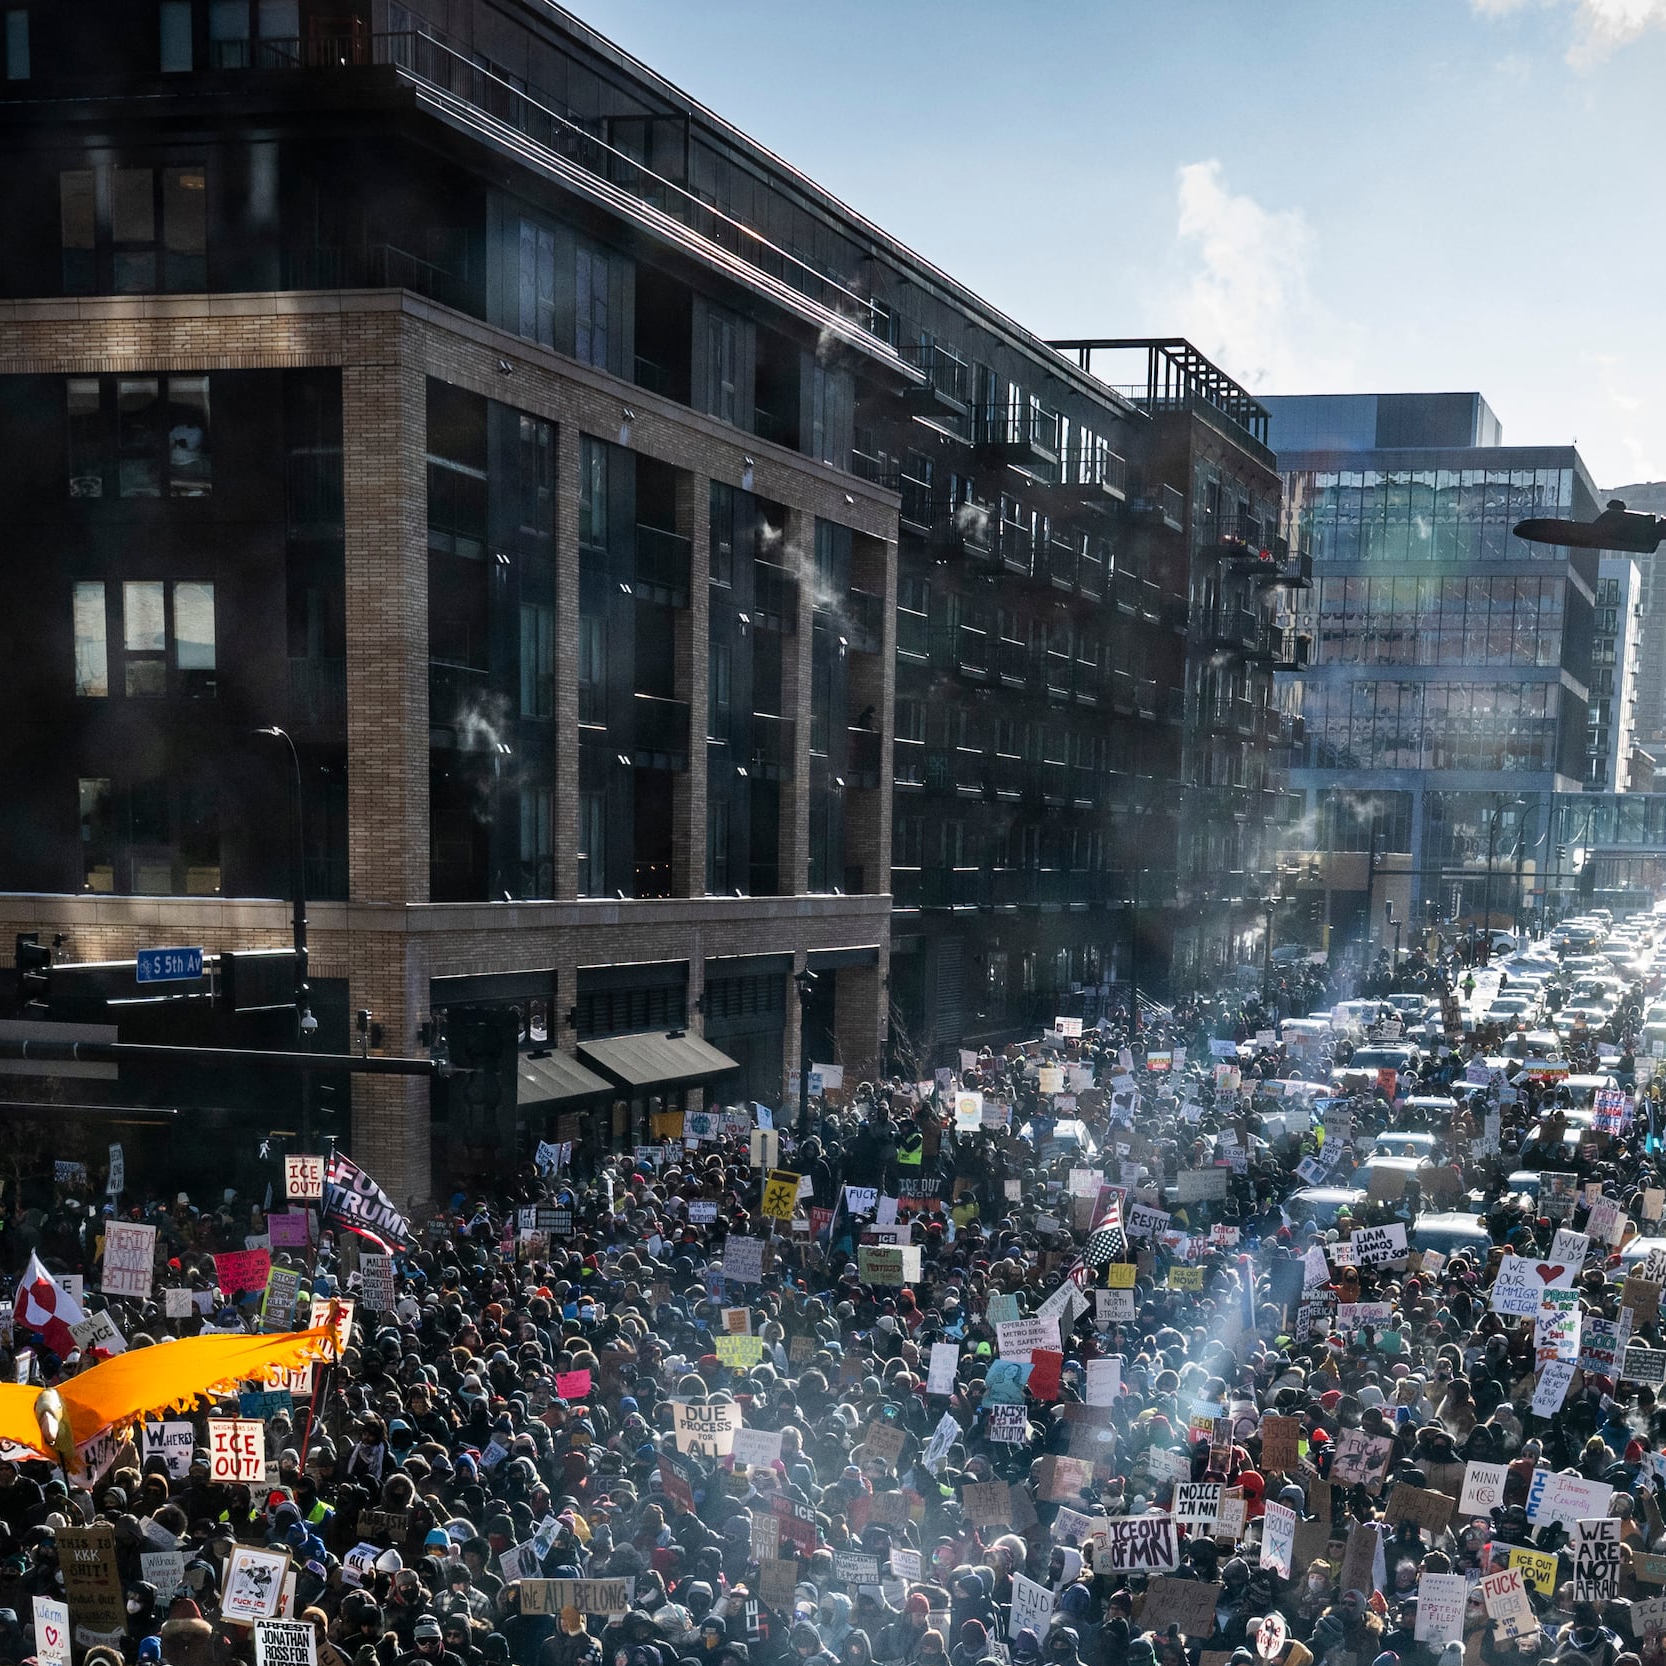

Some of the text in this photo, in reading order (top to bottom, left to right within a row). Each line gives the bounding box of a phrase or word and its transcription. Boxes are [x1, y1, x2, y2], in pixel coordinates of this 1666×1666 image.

[154, 957, 202, 973] S 5th Av
[289, 1165, 318, 1179] ICE
[290, 1181, 320, 1195] OUT!
[1357, 1229, 1386, 1244] LIAM
[1356, 1239, 1393, 1254] RAMOS
[1391, 1248, 1408, 1258] SON
[1104, 1298, 1127, 1306] NORTH
[1099, 1311, 1133, 1319] STRONGER
[686, 1406, 727, 1421] DUE
[994, 1406, 1026, 1417] RACISM
[680, 1419, 732, 1432] PROCESS
[698, 1433, 714, 1441] FOR
[687, 1440, 718, 1458] ALL
[793, 1505, 815, 1521] ICE
[1579, 1522, 1615, 1541] WE
[1579, 1541, 1619, 1561] ARE
[1576, 1561, 1618, 1581] NOT
[1576, 1579, 1619, 1600] AFRAID
[256, 1621, 311, 1633] ARREST
[262, 1631, 310, 1648] JONATHAN
[265, 1647, 309, 1663] ROSS FOR
